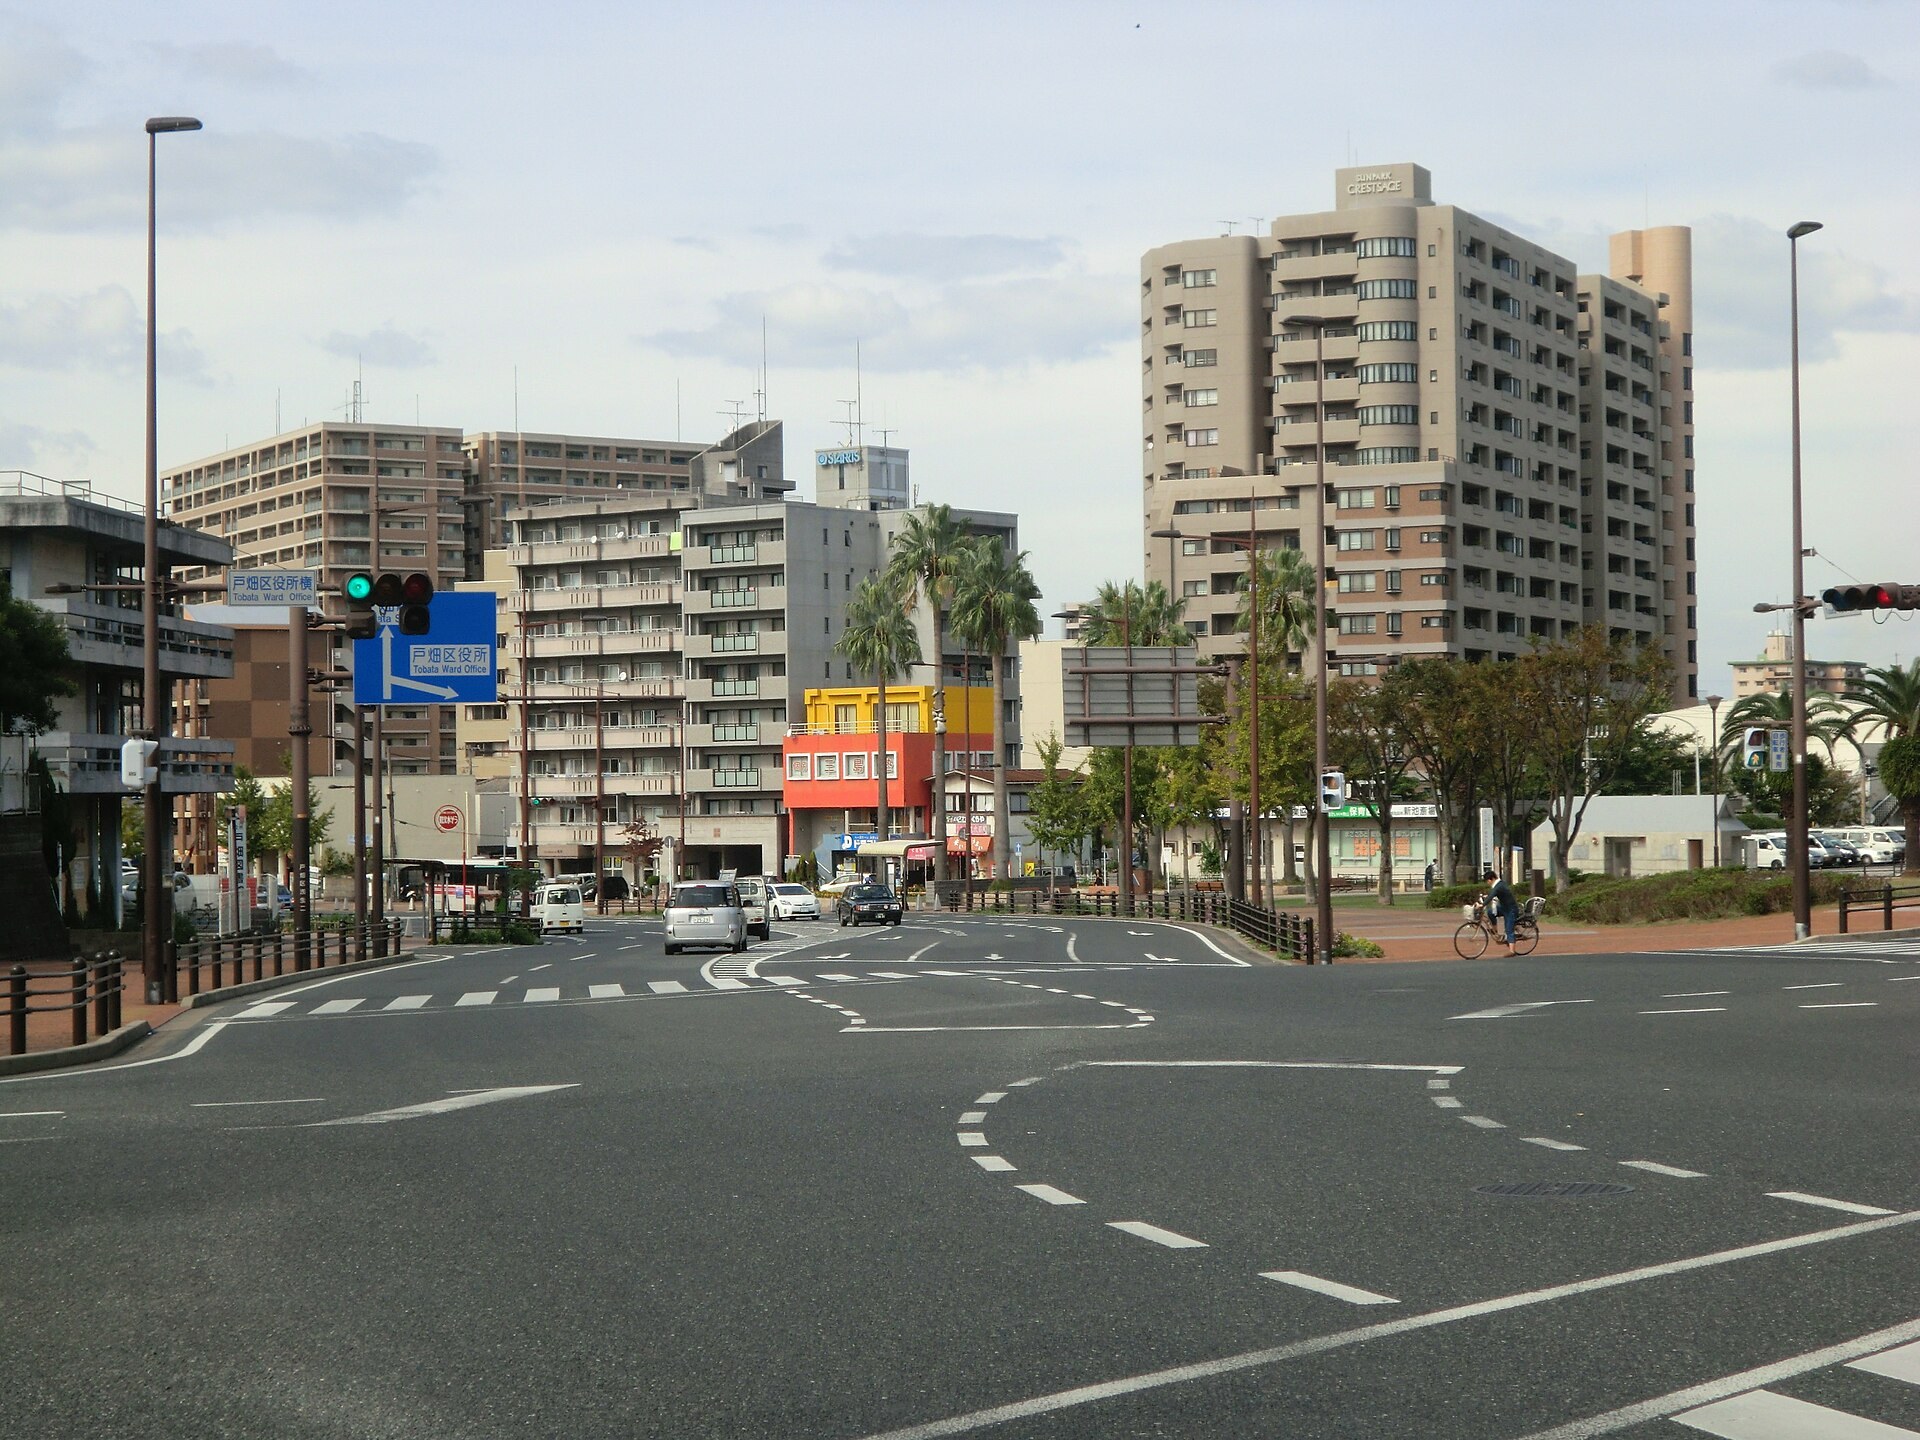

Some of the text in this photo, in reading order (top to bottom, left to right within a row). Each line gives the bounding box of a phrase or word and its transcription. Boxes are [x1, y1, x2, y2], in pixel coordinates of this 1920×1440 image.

[1357, 172, 1392, 181] SUNPARK
[233, 575, 312, 591] 戸畑区役所横
[233, 592, 312, 602] Tobata Ward Office
[412, 647, 487, 663] 戸畑区役所
[413, 665, 487, 674] Tobata Ward Office
